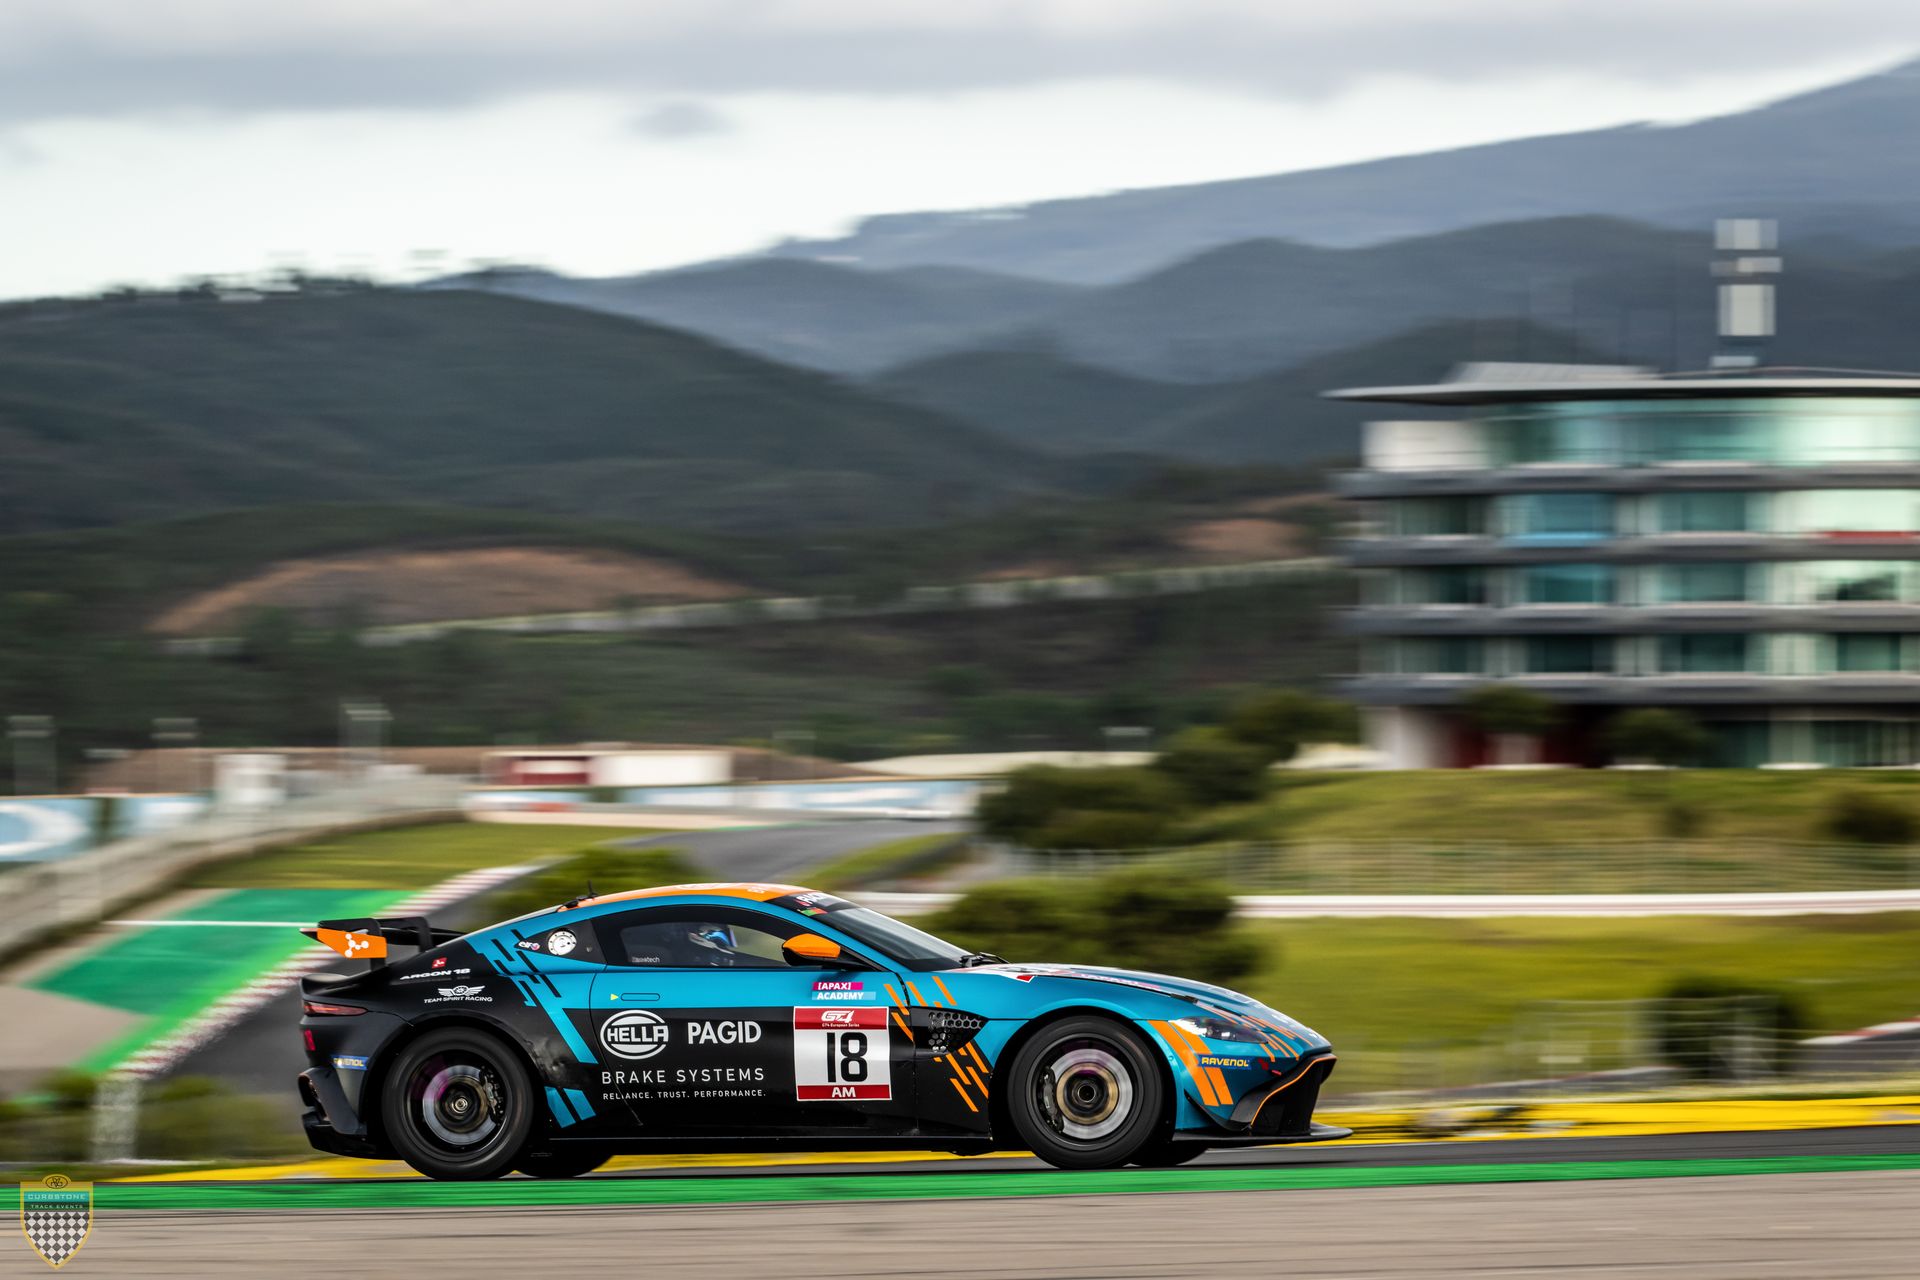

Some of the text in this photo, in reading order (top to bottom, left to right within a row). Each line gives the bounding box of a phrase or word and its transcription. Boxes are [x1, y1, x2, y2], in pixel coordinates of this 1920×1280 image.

[400, 970, 453, 980] ARGON
[817, 982, 852, 990] [APAX]
[817, 992, 864, 1000] ACADEMY
[606, 1025, 669, 1042] HELLA
[688, 1021, 762, 1044] PAGID
[827, 1032, 868, 1083] 18
[602, 1068, 764, 1084] BRAKE SYSTEMS
[603, 1092, 654, 1100] RELIANCE.
[694, 1089, 766, 1098] PERFORMANCE.
[831, 1087, 856, 1098] AM
